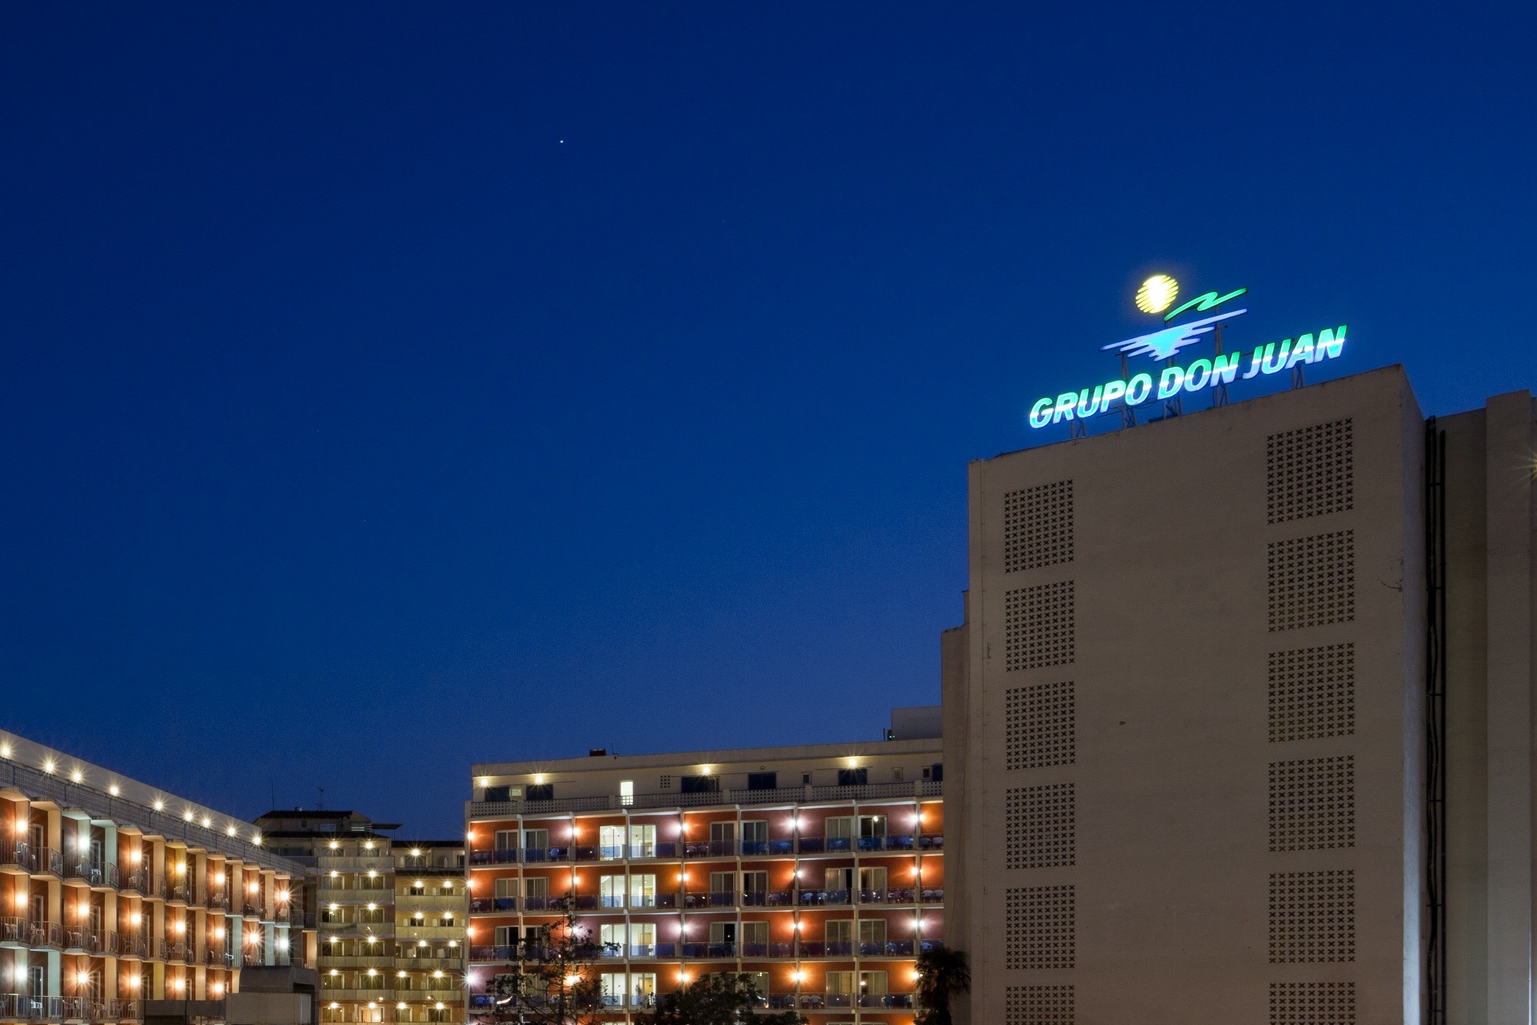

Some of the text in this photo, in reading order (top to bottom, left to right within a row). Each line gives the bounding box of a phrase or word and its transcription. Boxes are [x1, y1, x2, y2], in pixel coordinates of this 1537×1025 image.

[1028, 324, 1349, 430] GRUPO DON JUAN
